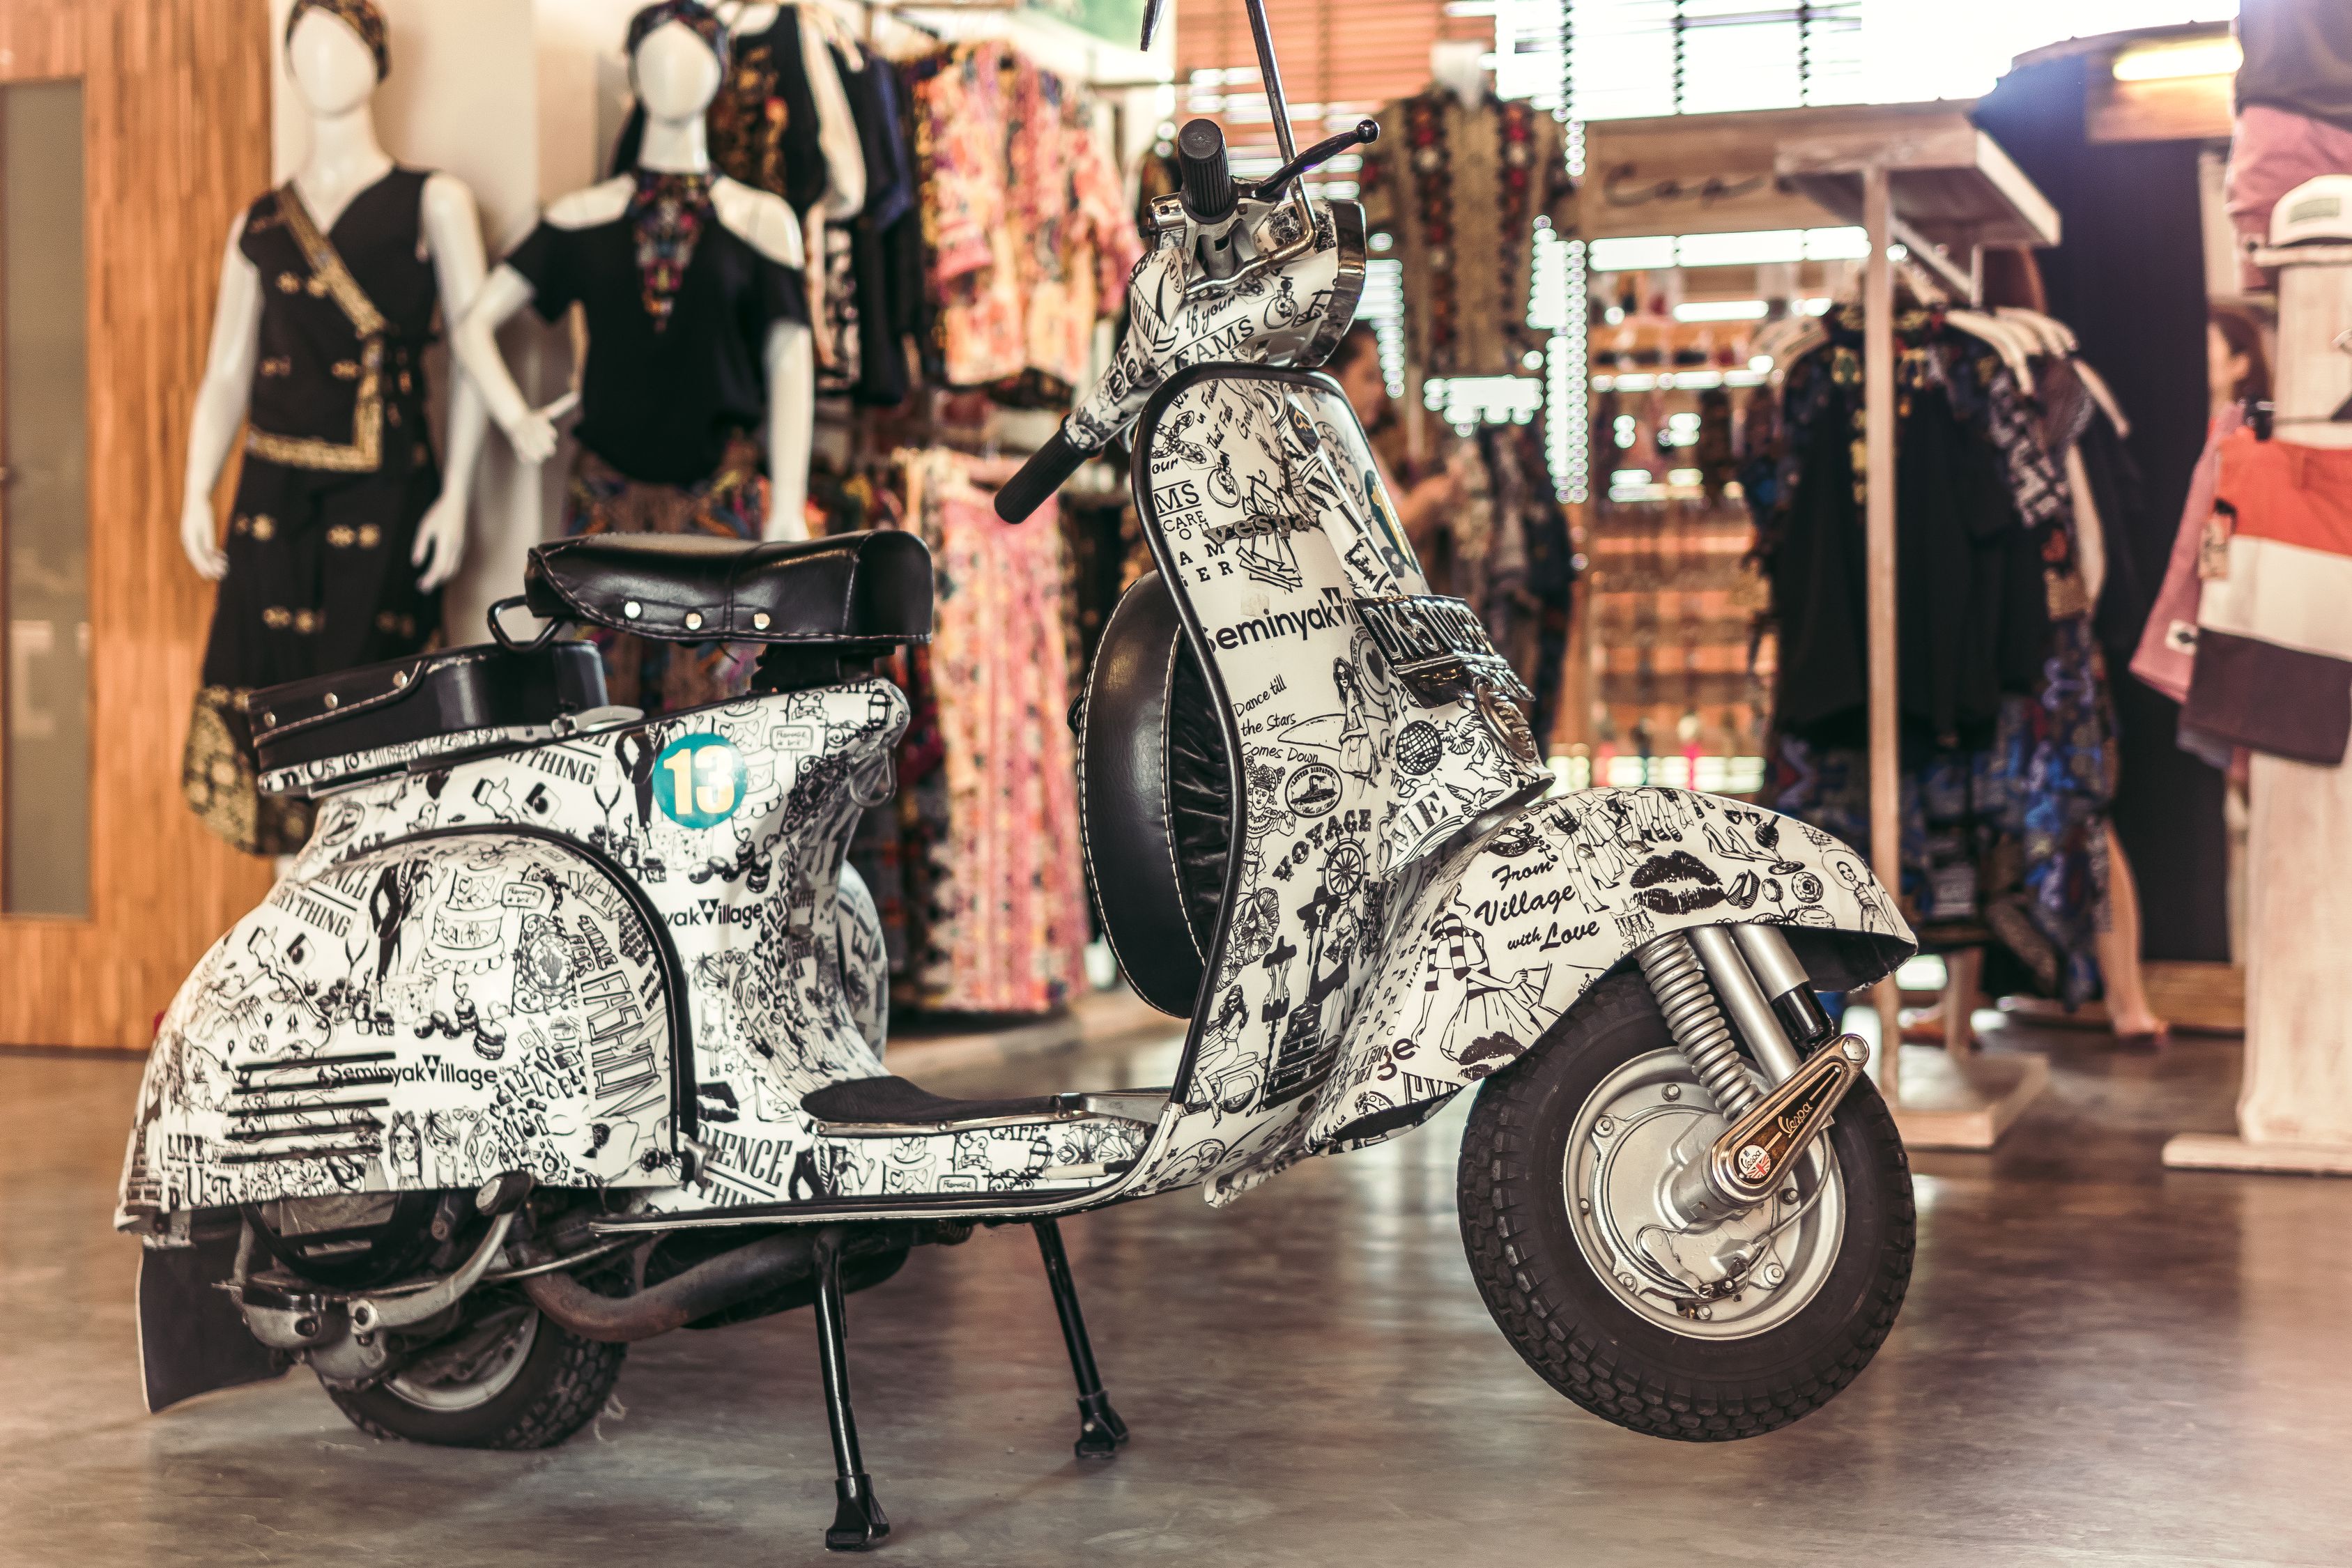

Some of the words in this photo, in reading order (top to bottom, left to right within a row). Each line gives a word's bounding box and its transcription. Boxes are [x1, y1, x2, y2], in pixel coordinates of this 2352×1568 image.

[1202, 294, 1236, 335] your
[1233, 691, 1270, 717] Dance
[1270, 674, 1288, 695] till
[1240, 718, 1263, 737] the
[1266, 713, 1298, 731] Stars
[1241, 741, 1284, 759] Comes
[1287, 747, 1319, 763] Down
[663, 744, 735, 815] 13
[1491, 861, 1554, 891] From
[1474, 885, 1576, 927] Village
[1507, 926, 1543, 951] with
[1539, 921, 1600, 953] Love
[1778, 1101, 1813, 1139] Vespa
